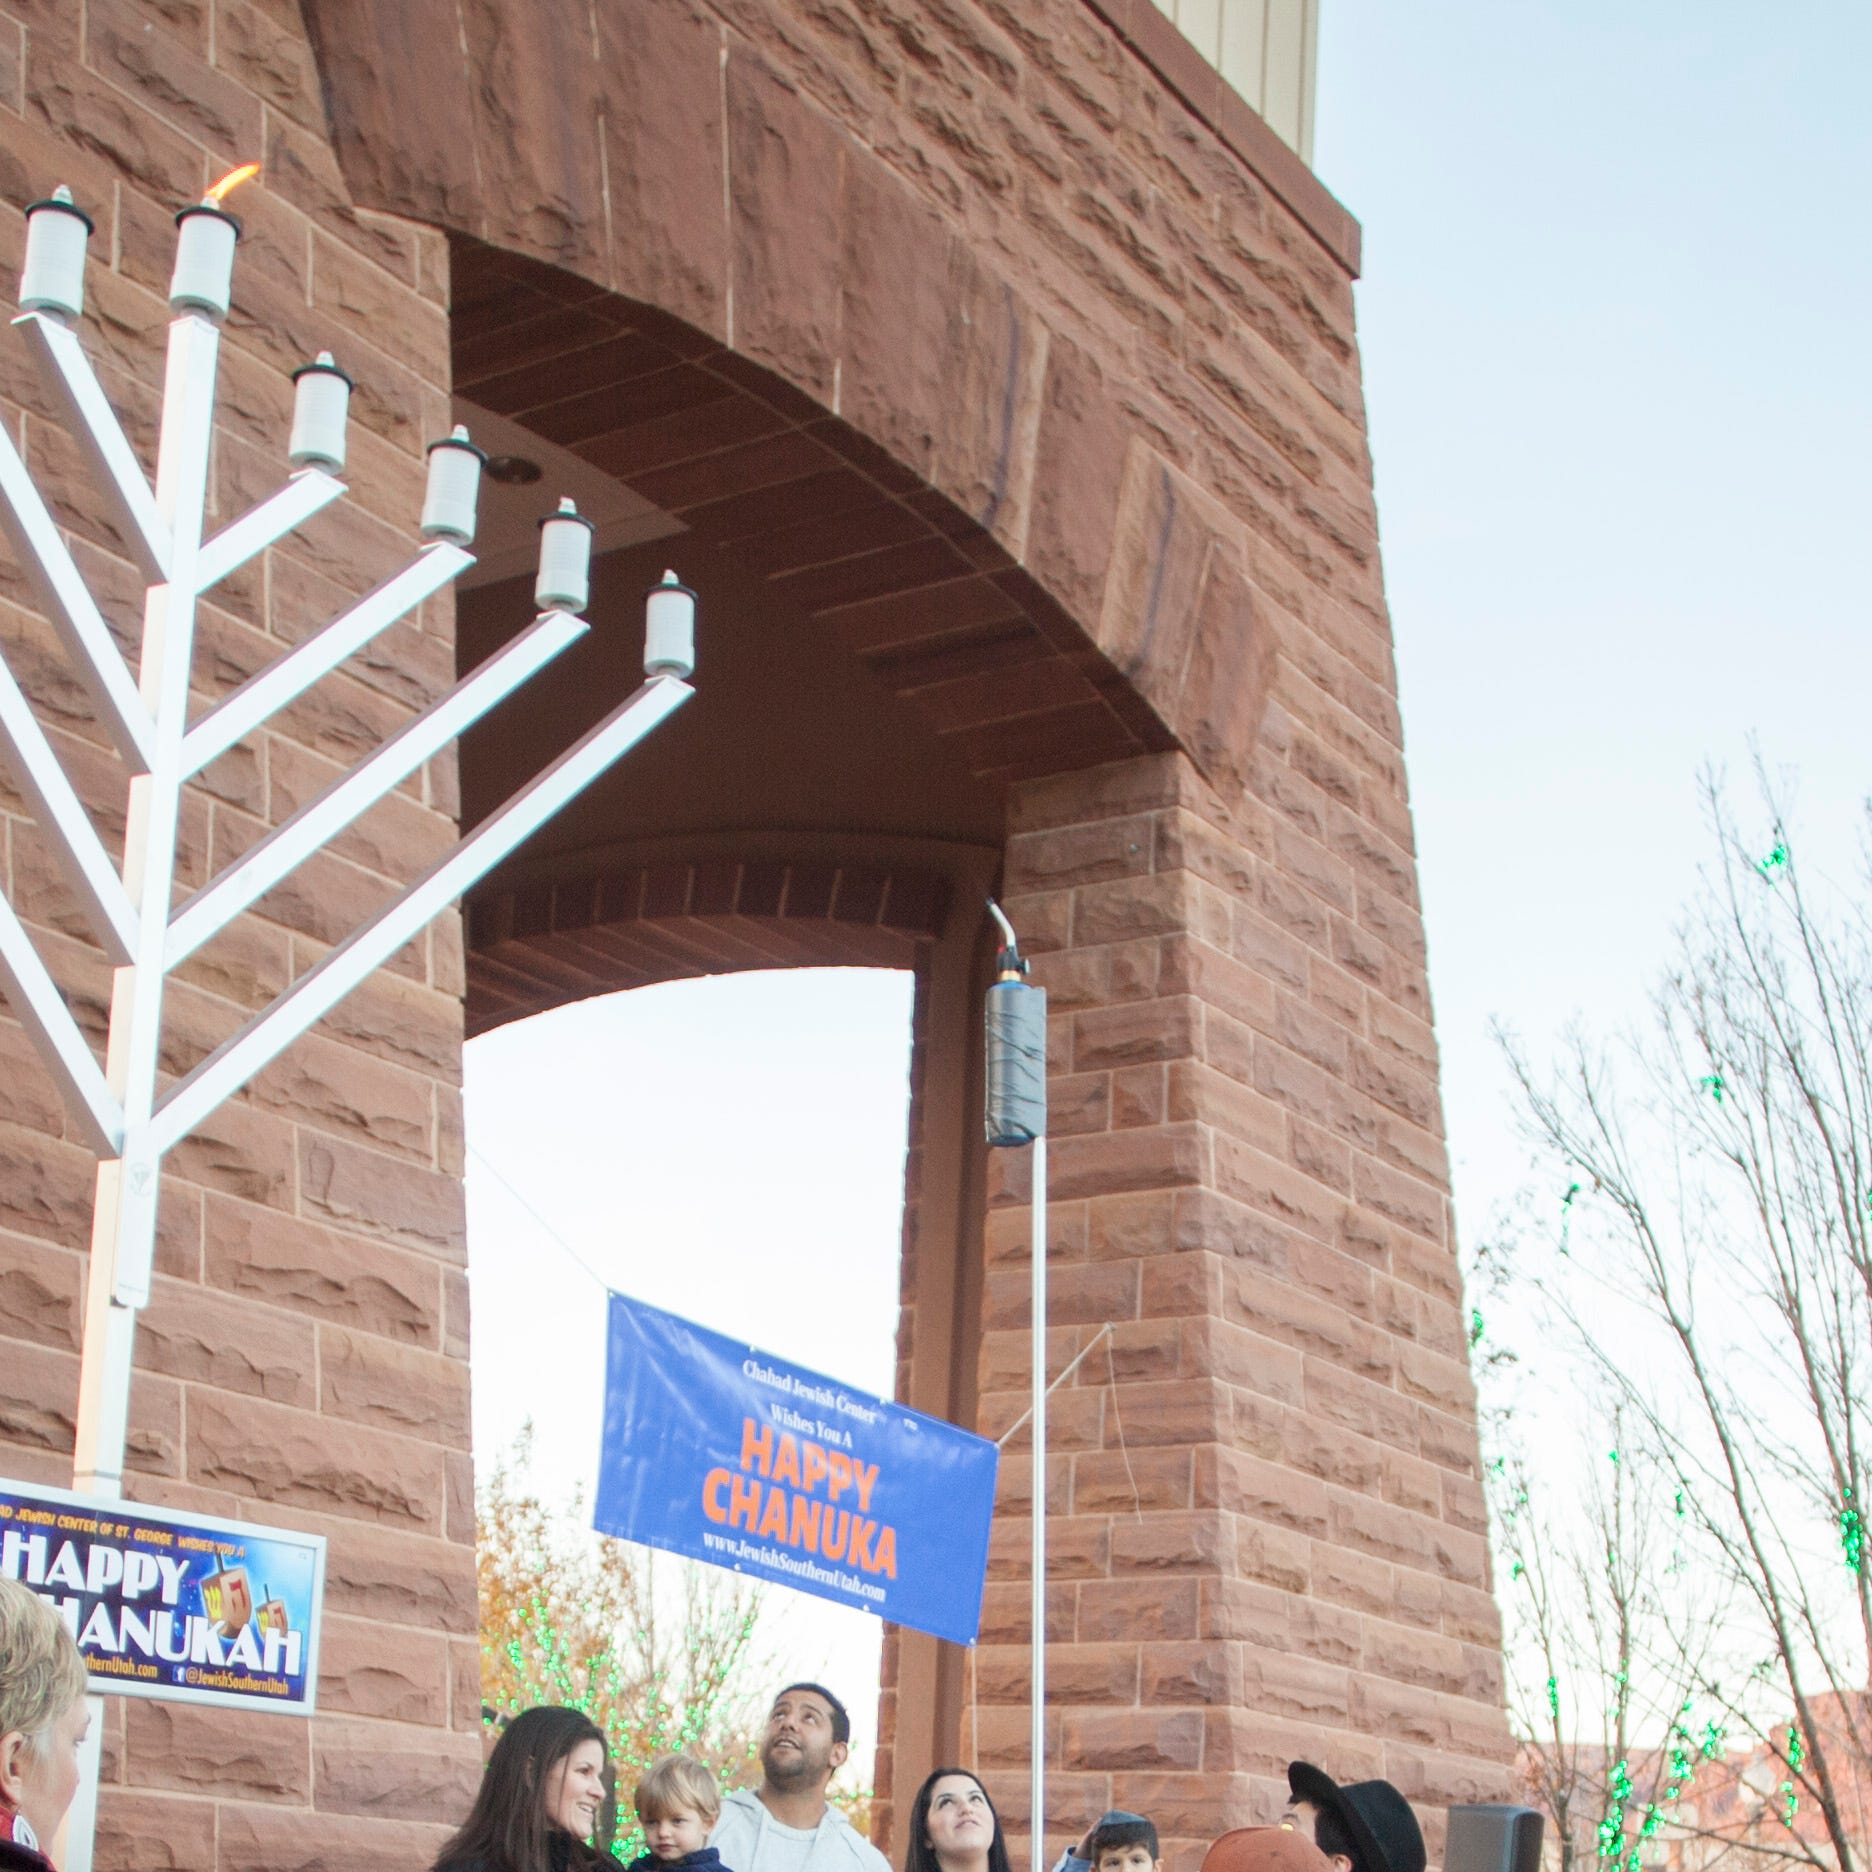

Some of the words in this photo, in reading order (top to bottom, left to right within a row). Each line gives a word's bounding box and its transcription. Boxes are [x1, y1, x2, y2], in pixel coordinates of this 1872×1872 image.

[742, 1360, 791, 1392] Chabad
[792, 1378, 834, 1410] Jewish
[836, 1393, 877, 1425] Center
[770, 1403, 814, 1433] Wishes
[816, 1418, 841, 1442] You
[842, 1430, 853, 1449] A
[740, 1416, 880, 1513] HAPPY
[15, 1508, 56, 1527] JEWISH
[57, 1515, 97, 1534] CENTER
[99, 1522, 114, 1536] OF
[115, 1525, 131, 1540] ST.
[133, 1528, 174, 1547] GEORGE
[178, 1536, 215, 1553] WISHES
[237, 1547, 246, 1559] A
[702, 1467, 898, 1580] CHANUKA
[1, 1530, 190, 1606] HAPPY
[703, 1531, 887, 1603] www.JewishSouthernUtah.com
[38, 1593, 303, 1677] HANUKAH
[83, 1651, 158, 1679] thernUtah.com
[186, 1664, 290, 1697] @JewishSouthernUtah
